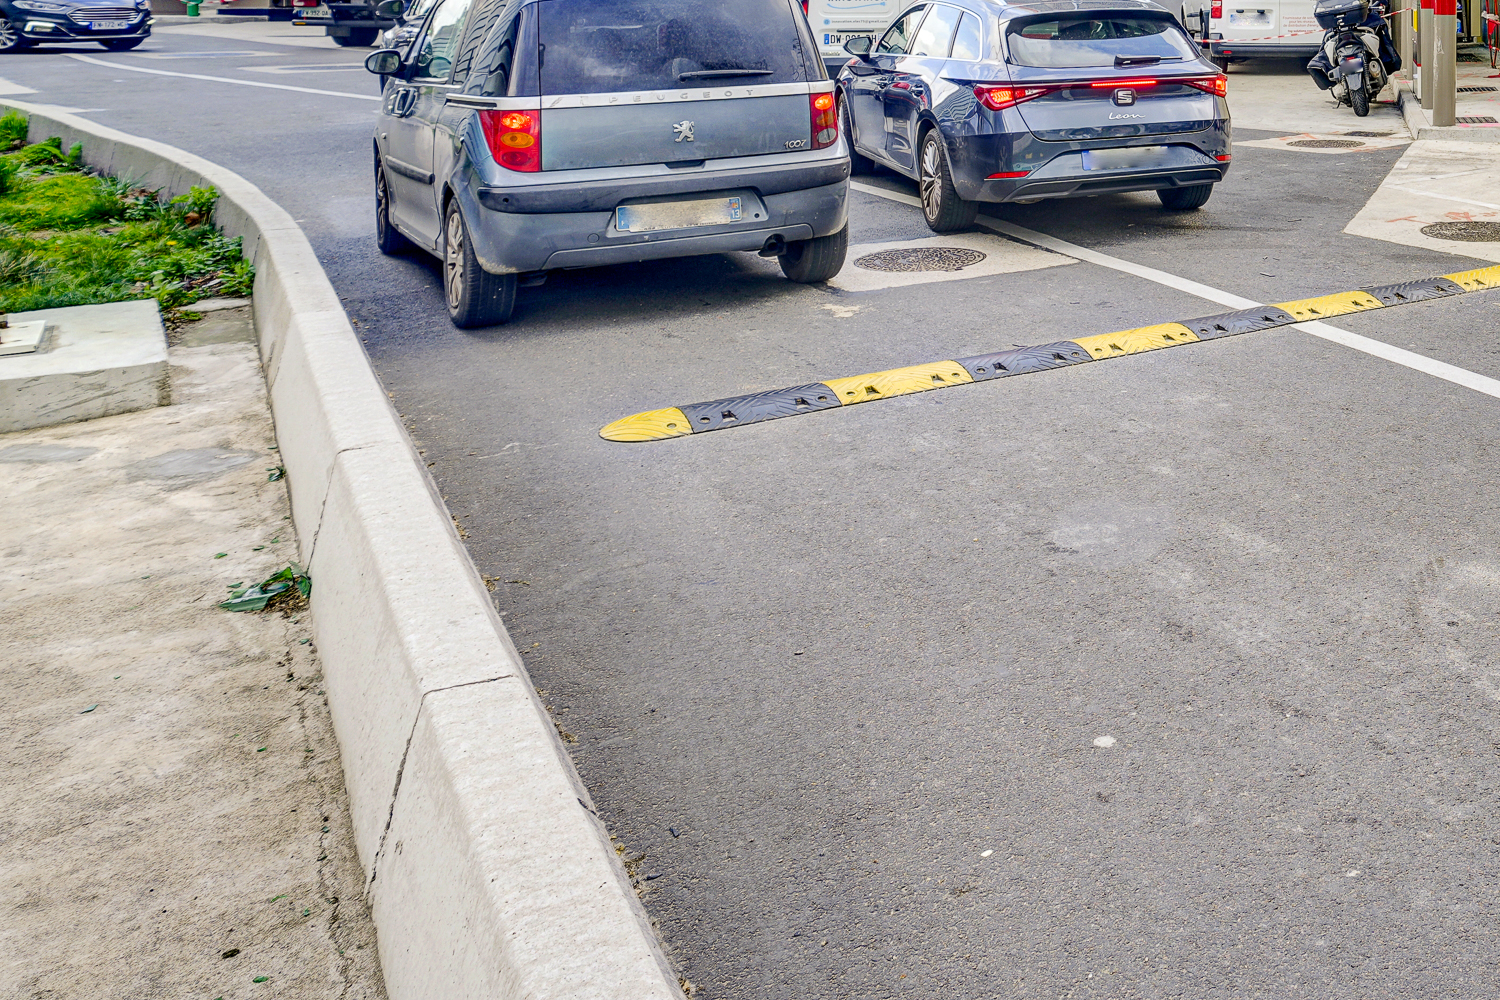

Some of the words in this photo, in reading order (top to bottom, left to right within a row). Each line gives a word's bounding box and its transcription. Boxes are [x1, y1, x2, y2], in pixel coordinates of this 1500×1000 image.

[608, 89, 754, 104] PEUGEOT
[1108, 111, 1146, 120] Leon
[783, 139, 807, 149] 1007
[732, 209, 740, 218] 13
